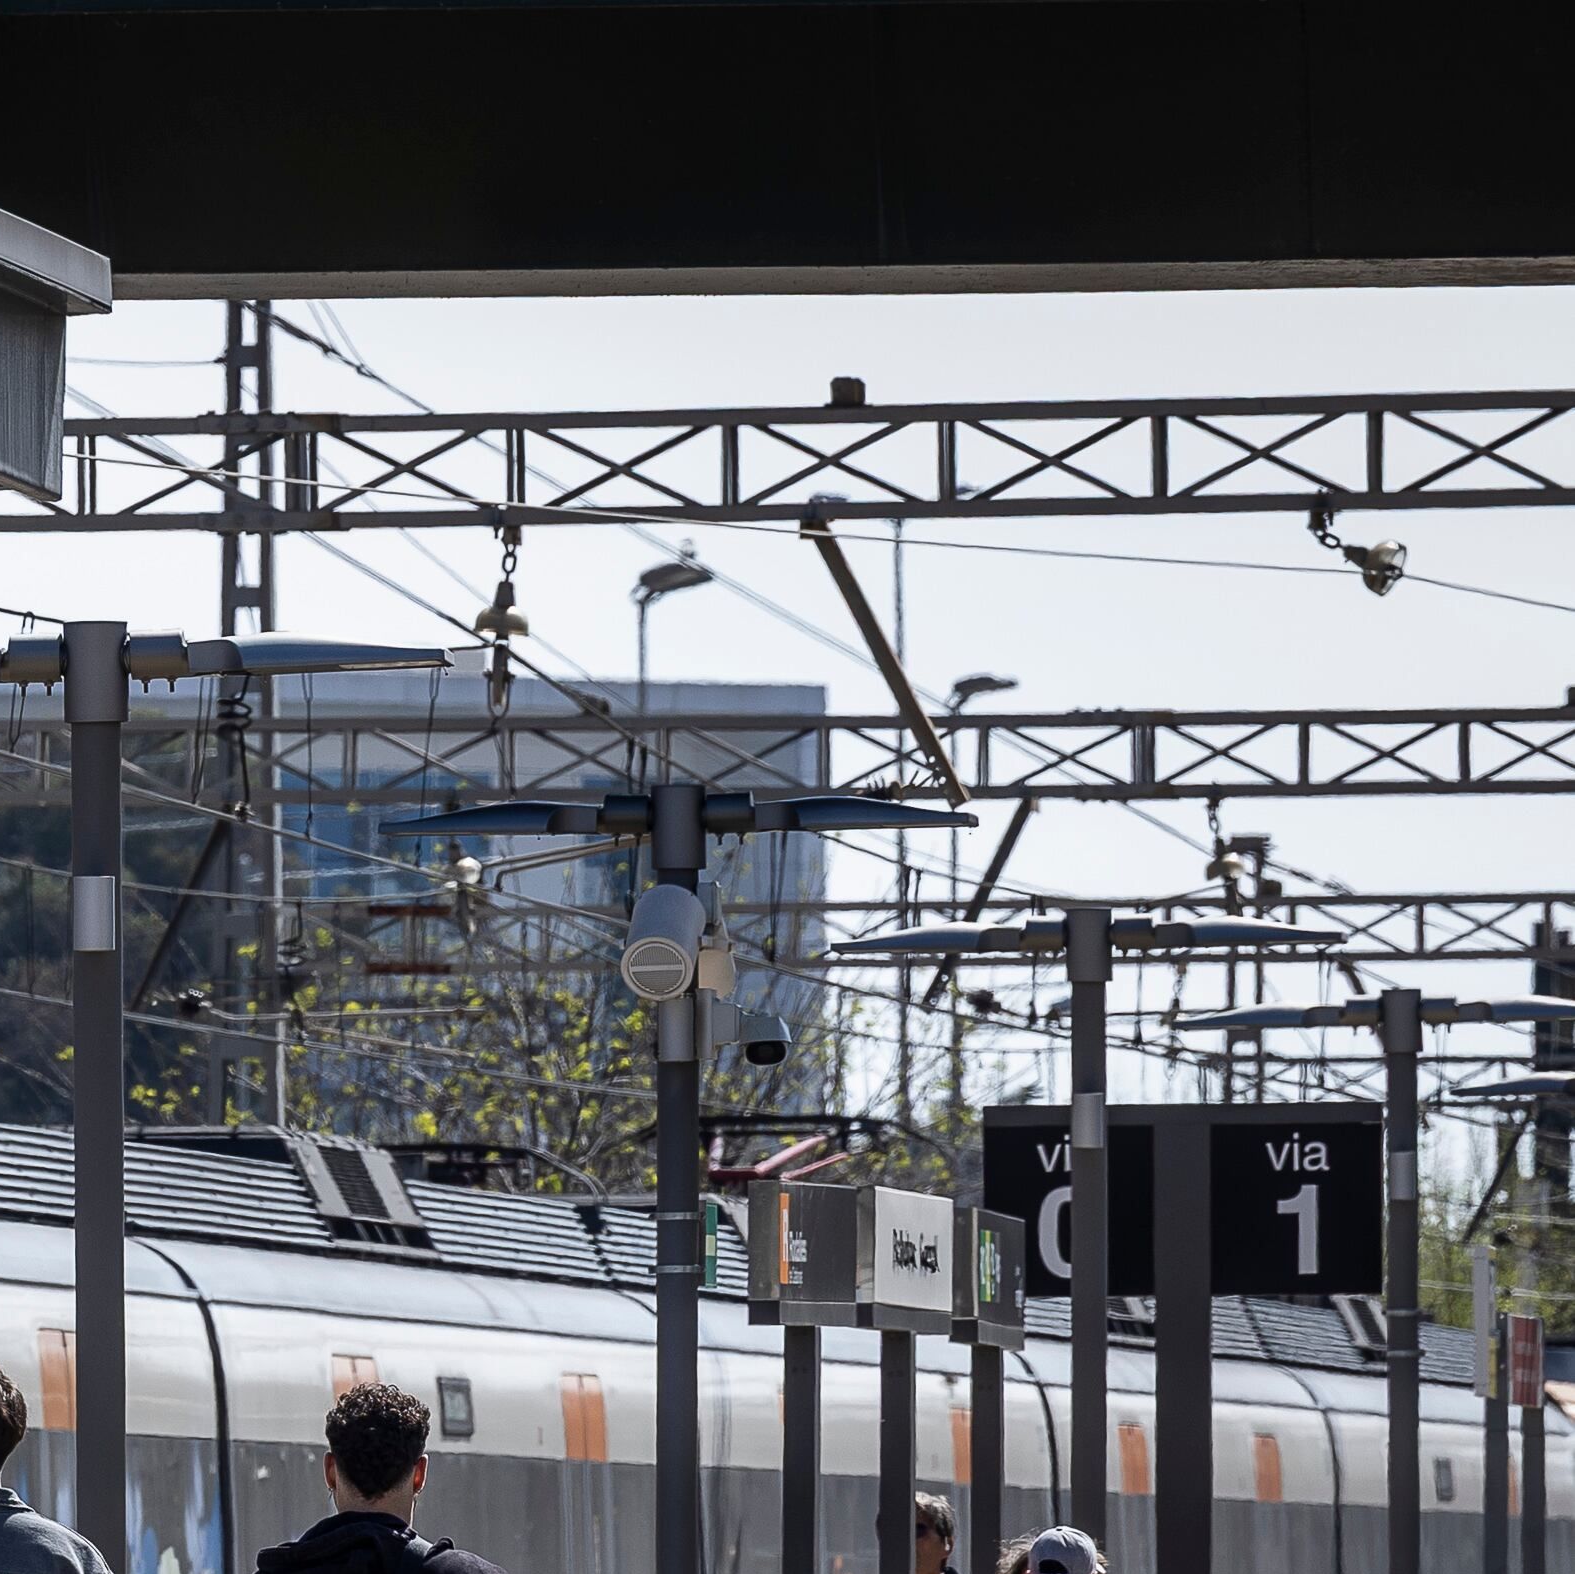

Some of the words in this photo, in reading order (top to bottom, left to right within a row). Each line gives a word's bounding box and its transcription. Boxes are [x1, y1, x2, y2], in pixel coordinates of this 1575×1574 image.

[1037, 1134, 1072, 1173] vi
[1266, 1132, 1330, 1172] via
[1276, 1184, 1319, 1275] 1
